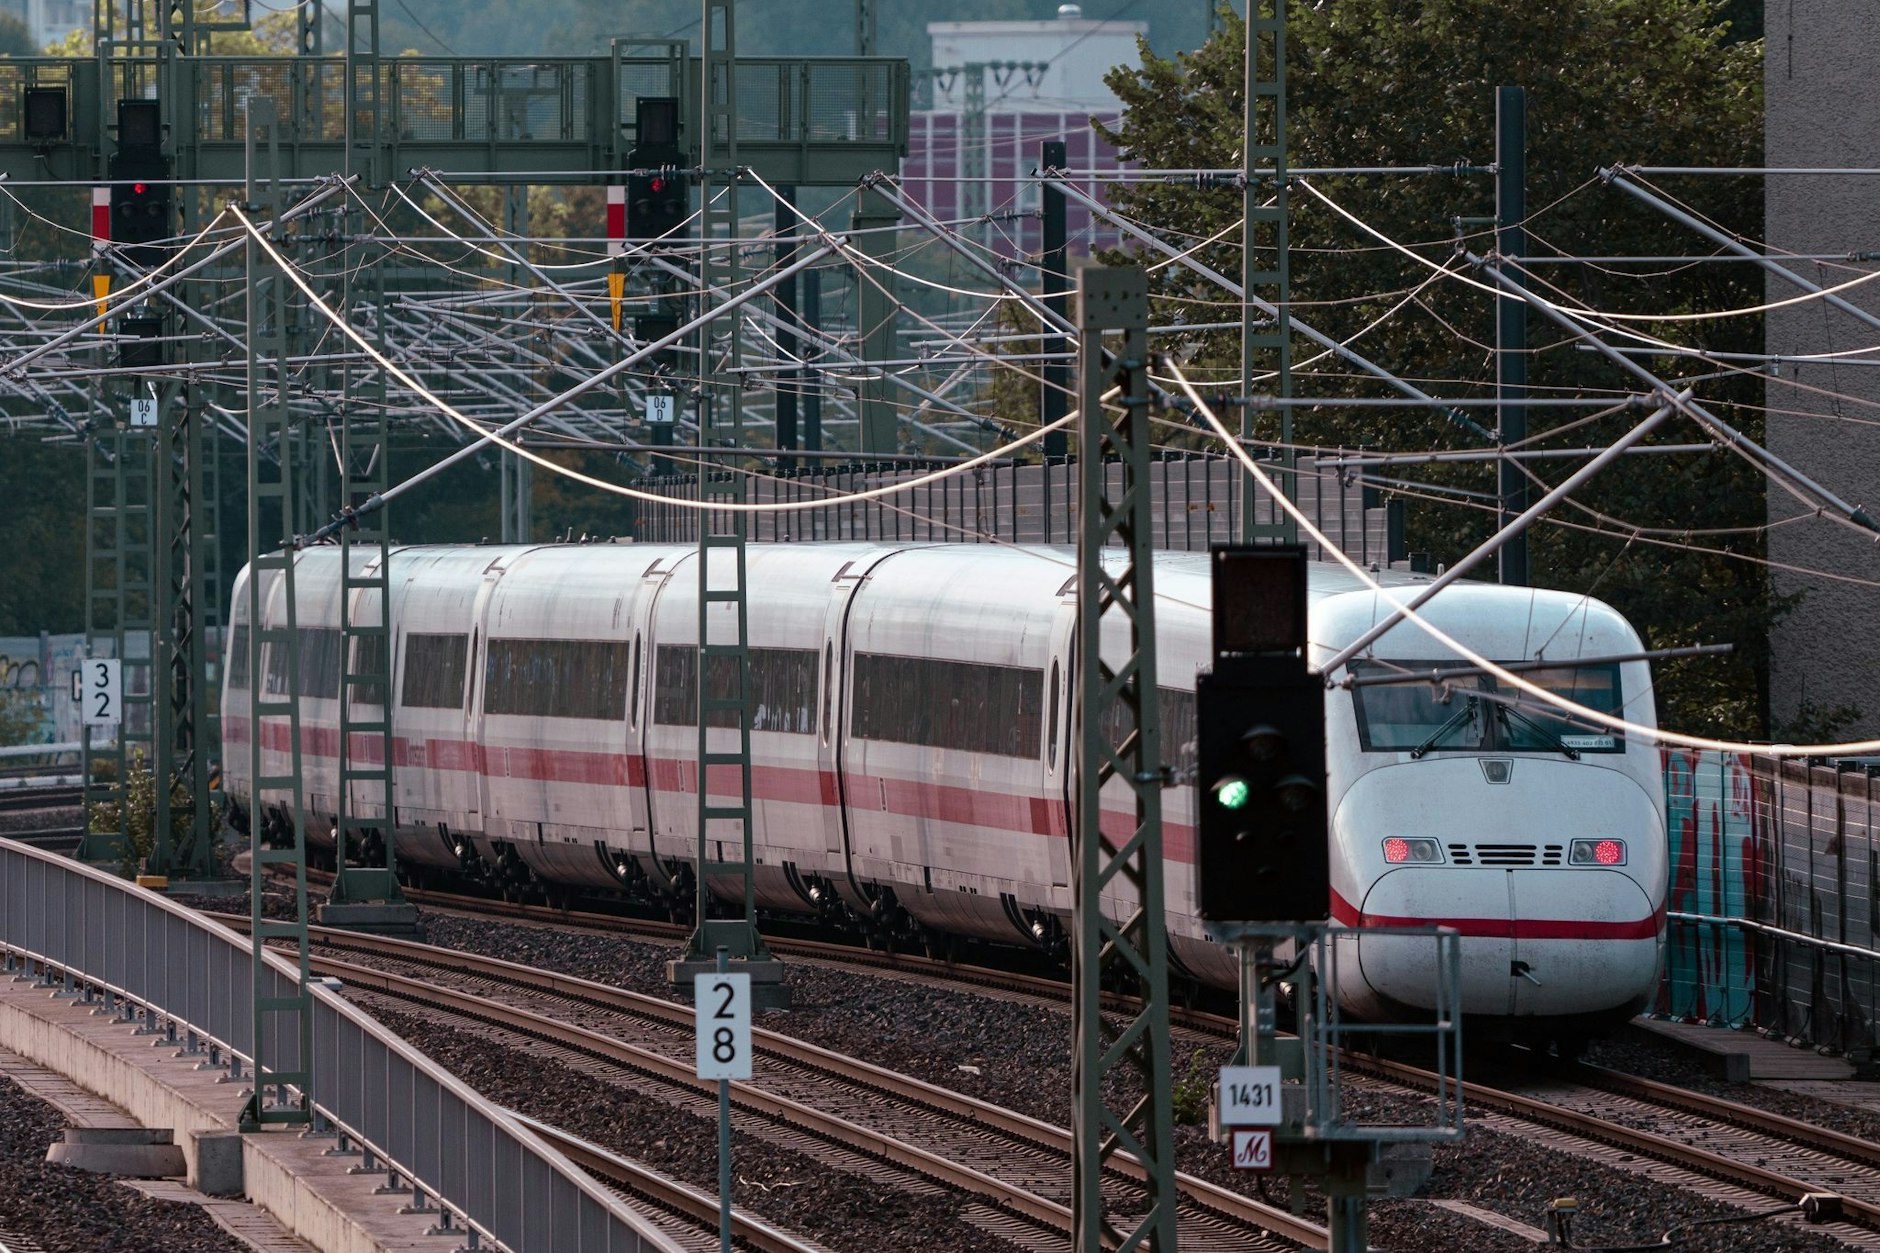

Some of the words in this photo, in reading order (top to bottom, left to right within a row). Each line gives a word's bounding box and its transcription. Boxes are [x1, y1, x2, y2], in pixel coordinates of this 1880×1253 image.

[138, 400, 150, 412] 06
[654, 396, 666, 409] 06
[141, 413, 147, 425] C
[95, 663, 109, 688] 3
[95, 692, 110, 718] 2
[712, 982, 735, 1019] 2
[713, 1027, 735, 1064] 8
[1229, 1083, 1273, 1108] 1431
[1237, 1136, 1268, 1163] M
